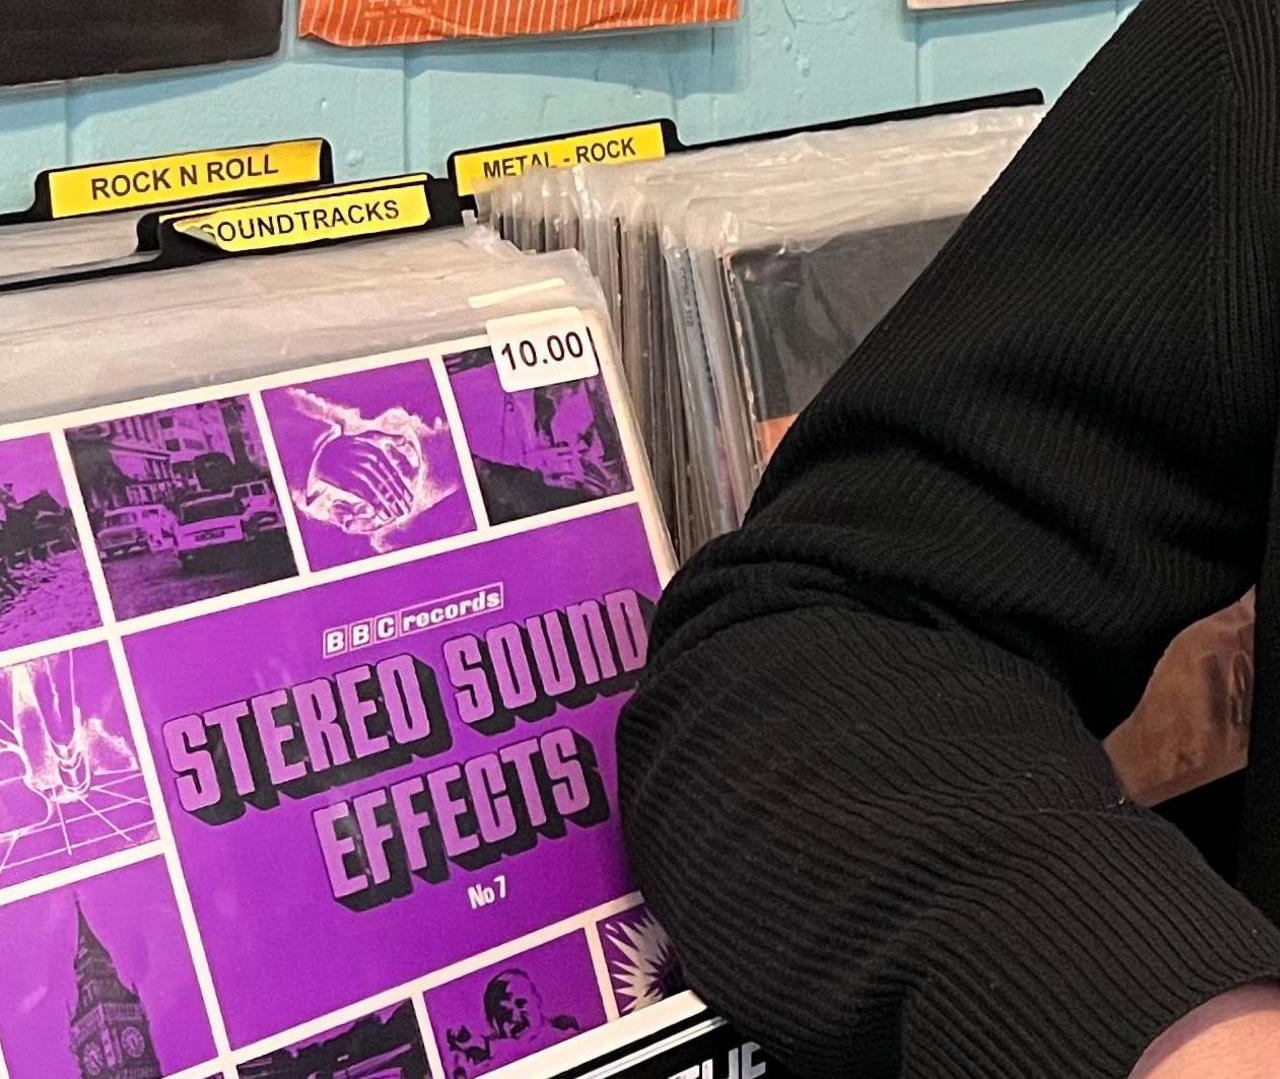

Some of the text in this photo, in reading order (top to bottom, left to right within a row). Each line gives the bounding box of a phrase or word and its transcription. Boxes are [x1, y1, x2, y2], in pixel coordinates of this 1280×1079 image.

[91, 154, 279, 200] ROCK N ROLL
[483, 151, 557, 178] METAL
[576, 137, 636, 163] ROCK
[201, 199, 400, 243] SOUNDTRACKS
[500, 331, 585, 370] 10.00
[326, 591, 501, 655] BBC records
[163, 588, 652, 815] STEREO SOUND
[312, 728, 600, 902] EFFECTS
